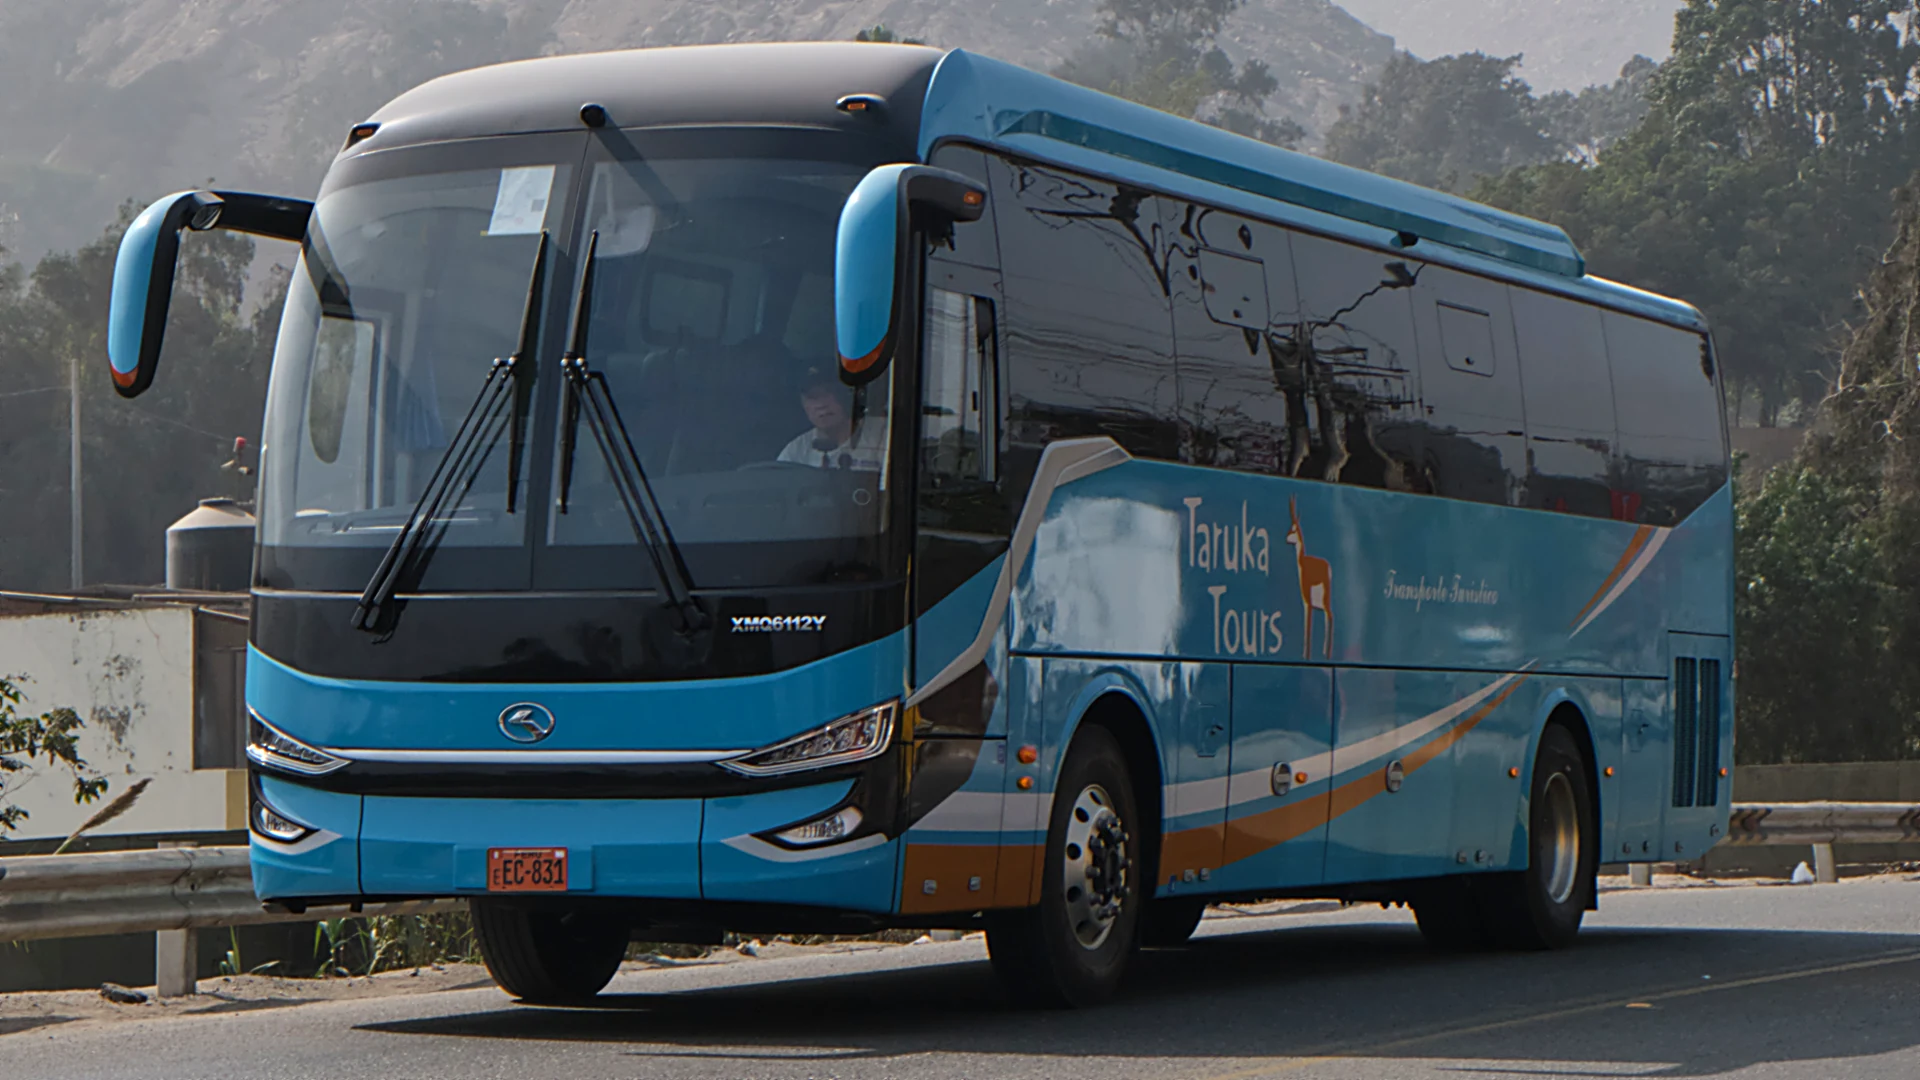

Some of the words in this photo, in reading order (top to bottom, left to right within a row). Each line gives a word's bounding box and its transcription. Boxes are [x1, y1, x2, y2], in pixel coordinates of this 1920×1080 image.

[1184, 497, 1270, 576] Taruka
[1384, 569, 1449, 613] Transporte
[731, 615, 827, 632] XMQ6112Y
[1208, 585, 1283, 656] Tours
[503, 859, 564, 885] EC-831
